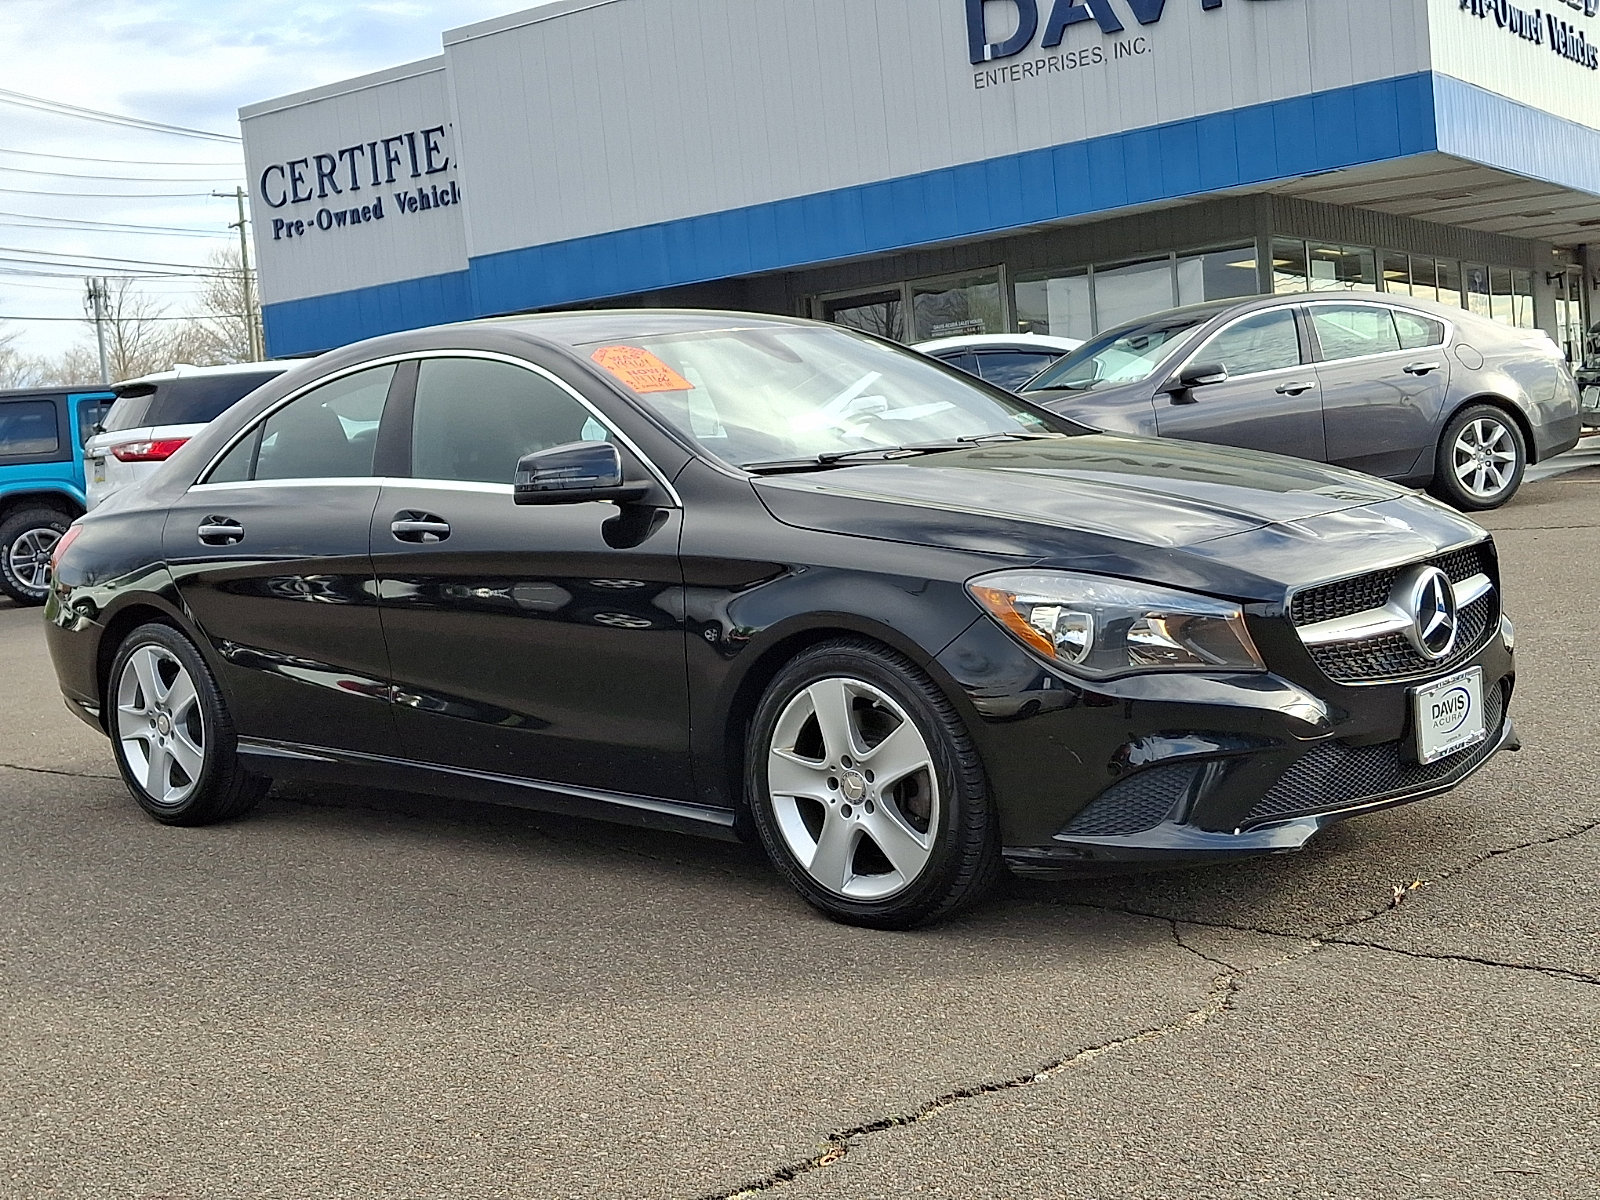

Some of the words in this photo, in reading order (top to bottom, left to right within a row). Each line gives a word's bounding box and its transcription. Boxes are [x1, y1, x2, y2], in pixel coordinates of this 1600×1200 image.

[973, 46, 1108, 90] ENTERPRISES,
[1114, 37, 1152, 60] INC.
[1546, 13, 1598, 70] Vehicles
[260, 123, 457, 208] CERTIFIE
[272, 196, 384, 240] Pre-Owned
[394, 181, 461, 215] Vehicl
[1432, 694, 1465, 719] DAVIS
[1432, 713, 1462, 728] ACURA
